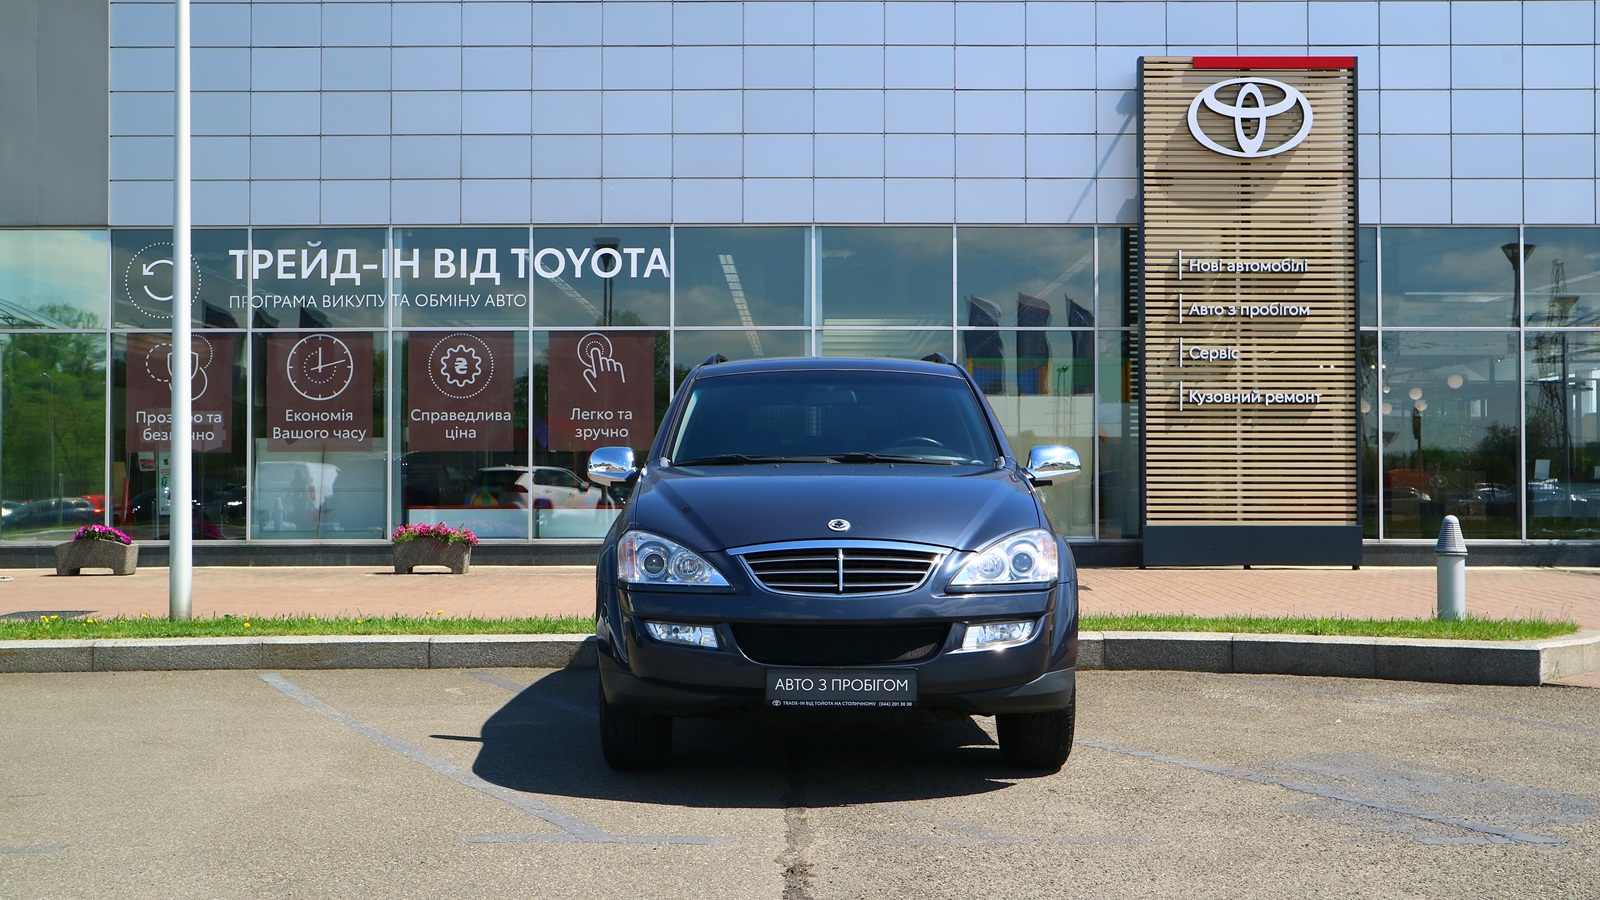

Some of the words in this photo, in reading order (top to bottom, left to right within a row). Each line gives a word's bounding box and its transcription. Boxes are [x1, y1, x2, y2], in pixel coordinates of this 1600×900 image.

[229, 241, 420, 286] ТРЕЙД-ІН
[434, 248, 500, 285] ВІД
[511, 247, 670, 279] TOYOTA
[1189, 258, 1222, 272] Нові
[1227, 258, 1309, 272] автомобілі
[229, 295, 315, 309] ПРОГРАМА
[322, 294, 387, 308] ВИКУПУ
[391, 294, 411, 307] ТА
[415, 294, 481, 307] ОБМІНУ
[484, 294, 527, 307] АВТО
[1189, 303, 1225, 316] Авто
[1228, 305, 1237, 316] з
[1240, 302, 1311, 319] пробігом
[1189, 346, 1240, 362] Сервіс
[1189, 390, 1261, 406] Кузовний
[1265, 393, 1323, 406] ремонт
[136, 411, 203, 426] Прозо
[207, 413, 222, 423] та
[285, 409, 353, 421] Економія
[410, 409, 511, 424] Справедлива
[570, 408, 613, 420] Легко
[617, 410, 633, 420] та
[272, 427, 329, 439] Вашого
[333, 429, 367, 442] часу
[445, 426, 477, 440] ціна
[575, 428, 629, 441] зручно
[774, 678, 814, 691] АВТО
[831, 678, 909, 692] ПРОБІГОМ
